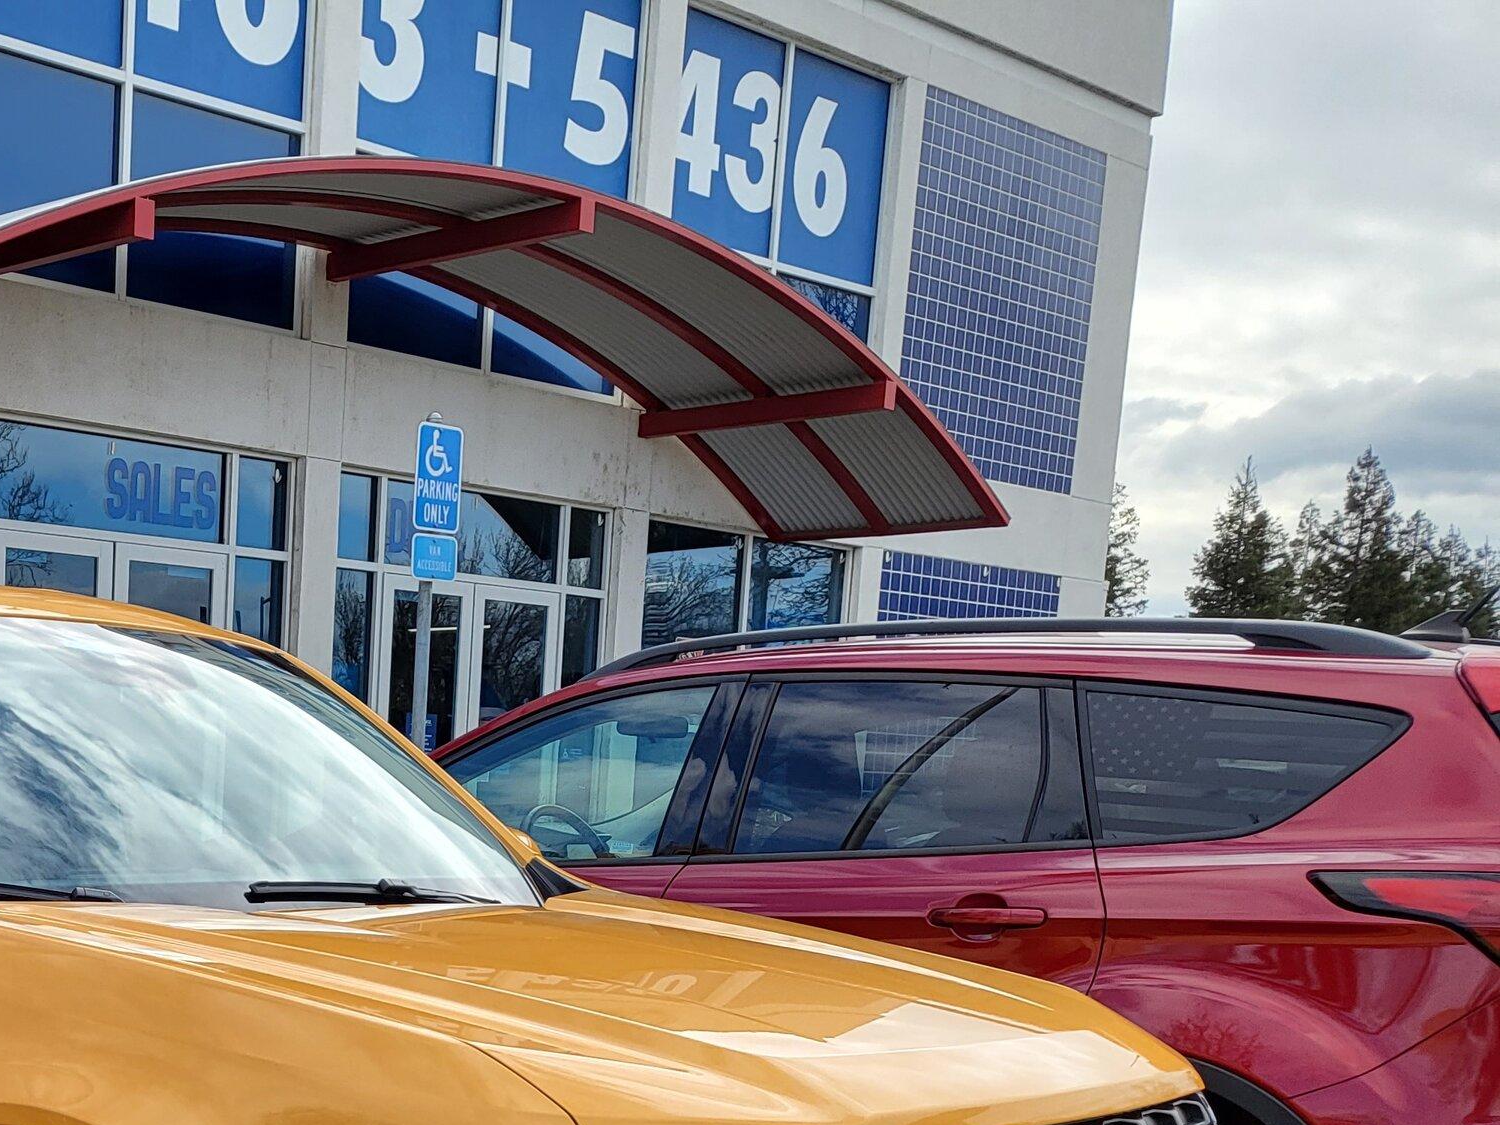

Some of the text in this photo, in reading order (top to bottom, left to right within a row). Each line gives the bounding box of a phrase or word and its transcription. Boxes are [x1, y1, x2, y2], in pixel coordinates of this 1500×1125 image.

[105, 457, 217, 530] SALES
[417, 477, 458, 502] PARKING
[423, 502, 450, 525] ONLY
[428, 545, 442, 556] VAN
[416, 559, 452, 573] ACCESSIBLE
